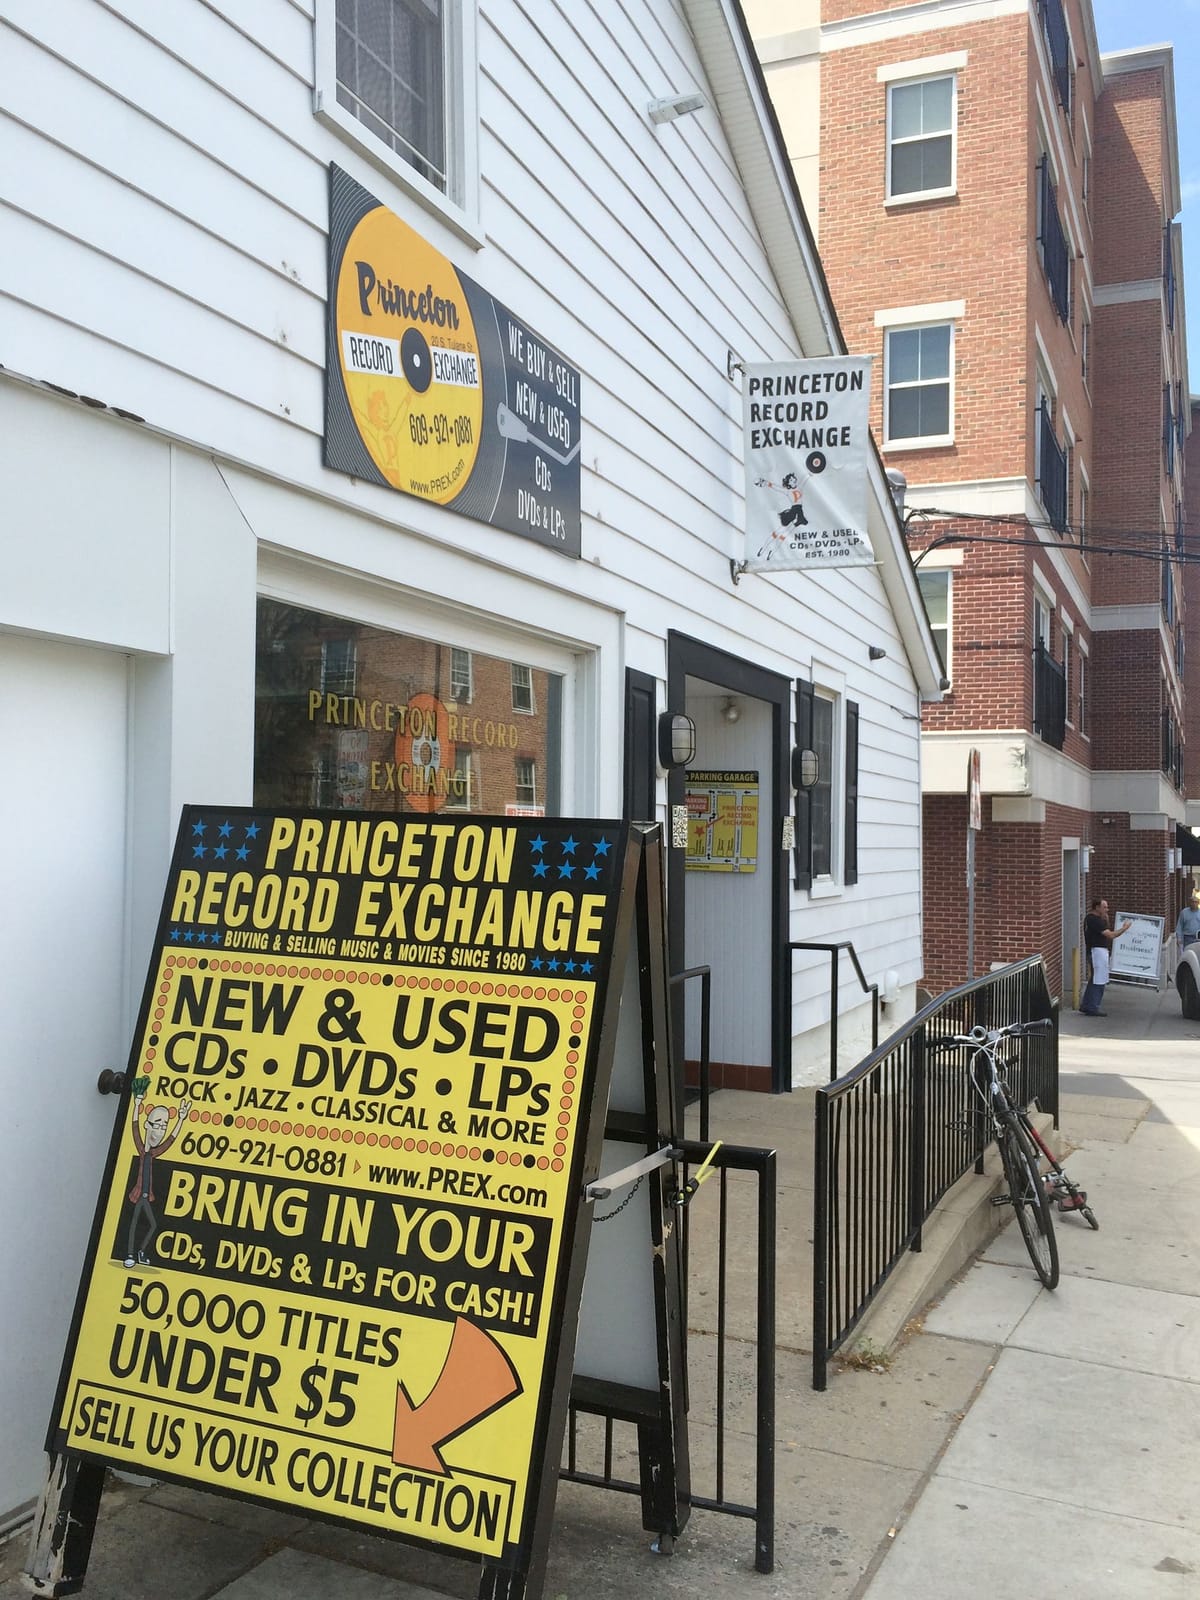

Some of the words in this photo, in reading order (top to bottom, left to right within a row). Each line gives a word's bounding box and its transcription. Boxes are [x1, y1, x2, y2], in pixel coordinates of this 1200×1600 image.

[355, 261, 459, 331] Princeton
[350, 336, 394, 375] RECORD
[433, 351, 478, 385] EXCHANGE
[508, 320, 524, 364] WE
[527, 341, 546, 381] BUY
[548, 360, 554, 384] &
[556, 364, 577, 408] SELL
[749, 370, 864, 397] PRINCETON
[516, 380, 537, 424] NEW
[539, 401, 545, 424] &
[547, 404, 570, 449] USED
[750, 400, 829, 423] RECORD
[751, 426, 851, 449] EXCHANGE
[409, 458, 465, 494] www.PREX.com
[535, 455, 552, 492] CDs
[518, 488, 541, 527] DVDs
[542, 506, 548, 529] &
[550, 505, 566, 540] LPs
[789, 542, 809, 550] CDs
[815, 540, 842, 548] DVDs
[794, 532, 818, 541] NEW
[821, 530, 829, 539] &
[805, 550, 824, 558] EST.
[827, 548, 850, 557] 1980
[308, 689, 437, 738] PRINCETON
[448, 713, 519, 749] RECORD
[690, 772, 723, 782] PARKING
[723, 773, 755, 783] GARAGE
[264, 817, 518, 884] PRINCETON
[170, 869, 340, 933] RECORD
[354, 880, 607, 954] EXCHANGE
[224, 930, 269, 950] BUYING
[273, 934, 281, 952] &
[286, 934, 336, 957] SELLING
[340, 939, 380, 960] MUSIC
[383, 942, 393, 960] &
[398, 943, 446, 965] MOVIES
[451, 949, 489, 968] SINCE
[495, 951, 526, 972] 1980
[171, 974, 304, 1036] NEW
[317, 988, 366, 1044] &
[392, 994, 560, 1062] USED
[164, 1031, 248, 1079] CDs
[291, 1043, 418, 1100] DVDs
[468, 1062, 551, 1116] LPs
[155, 1076, 219, 1103] ROCK
[233, 1086, 291, 1112] JAZZ
[311, 1095, 429, 1131] CLASSICAL
[437, 1110, 458, 1135] &
[467, 1114, 547, 1146] MORE
[180, 1131, 347, 1178] 609-921-0881
[368, 1164, 548, 1208] www.PREX.com
[164, 1169, 309, 1237] BRING
[321, 1193, 375, 1249] IN
[391, 1202, 535, 1277] YOUR
[155, 1230, 207, 1271] CDs,
[215, 1239, 283, 1279] DVDs
[290, 1253, 313, 1285] &
[322, 1258, 367, 1294] LPs
[373, 1266, 437, 1307] FOR
[445, 1281, 535, 1326] CASH!
[119, 1276, 266, 1340] 50,000
[278, 1306, 402, 1368] TITLES
[109, 1323, 282, 1414] UNDER
[294, 1358, 360, 1428] $5
[74, 1396, 135, 1450] SELL
[146, 1411, 185, 1460] US
[194, 1422, 278, 1485] YOUR
[287, 1447, 502, 1541] COLLECTION
